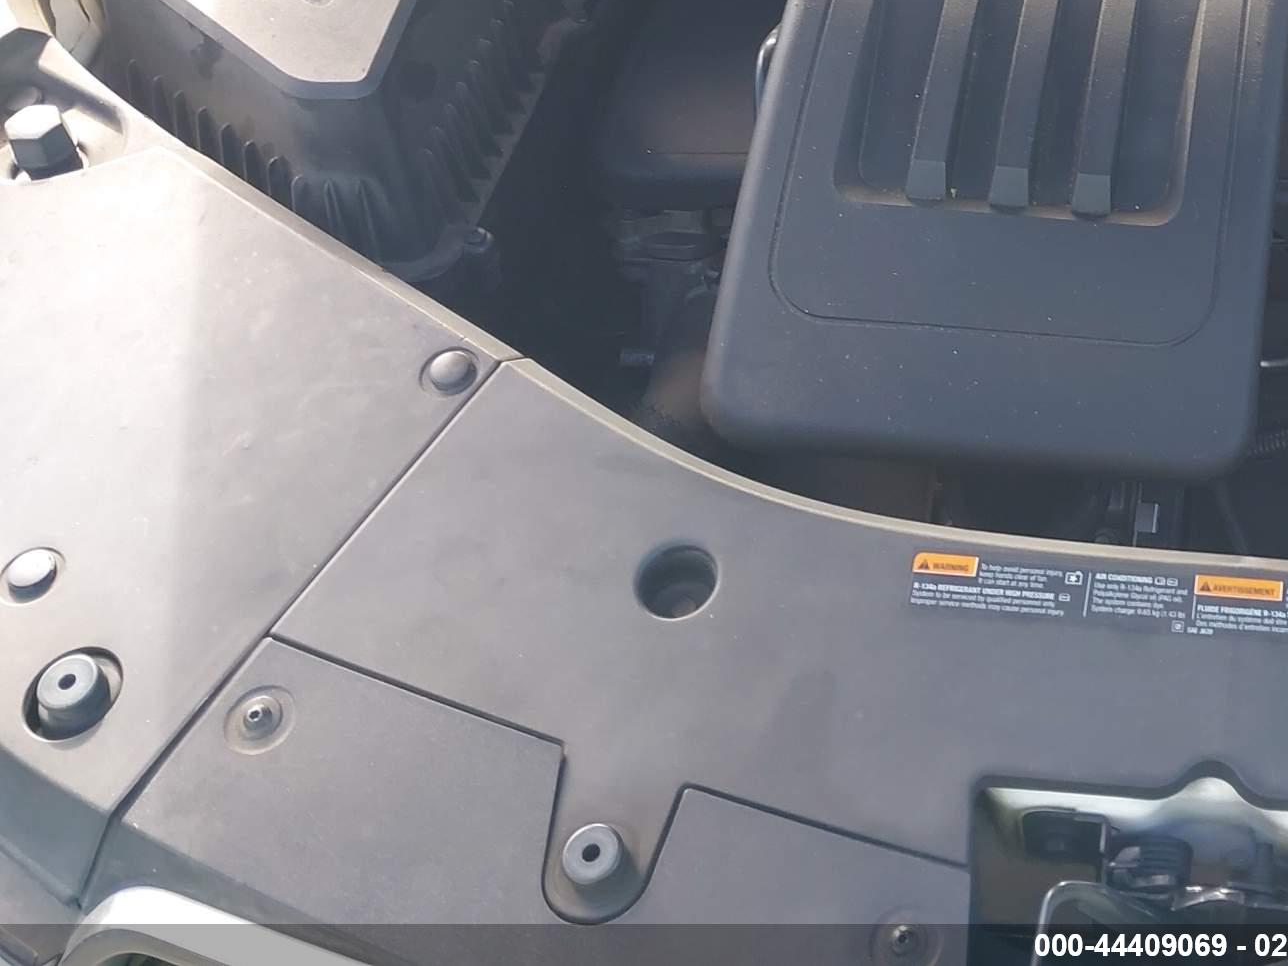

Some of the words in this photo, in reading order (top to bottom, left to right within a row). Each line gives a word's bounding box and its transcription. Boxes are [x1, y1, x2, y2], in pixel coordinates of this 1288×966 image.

[932, 562, 969, 572] WARNING
[1108, 573, 1153, 584] CONDITIONING
[937, 584, 981, 594] REFRIGERANT
[982, 587, 1004, 596] UNDER
[1005, 589, 1021, 597] HIGH
[1022, 590, 1055, 600] PRESSURE
[1212, 584, 1275, 596] AVERTISSEMENT
